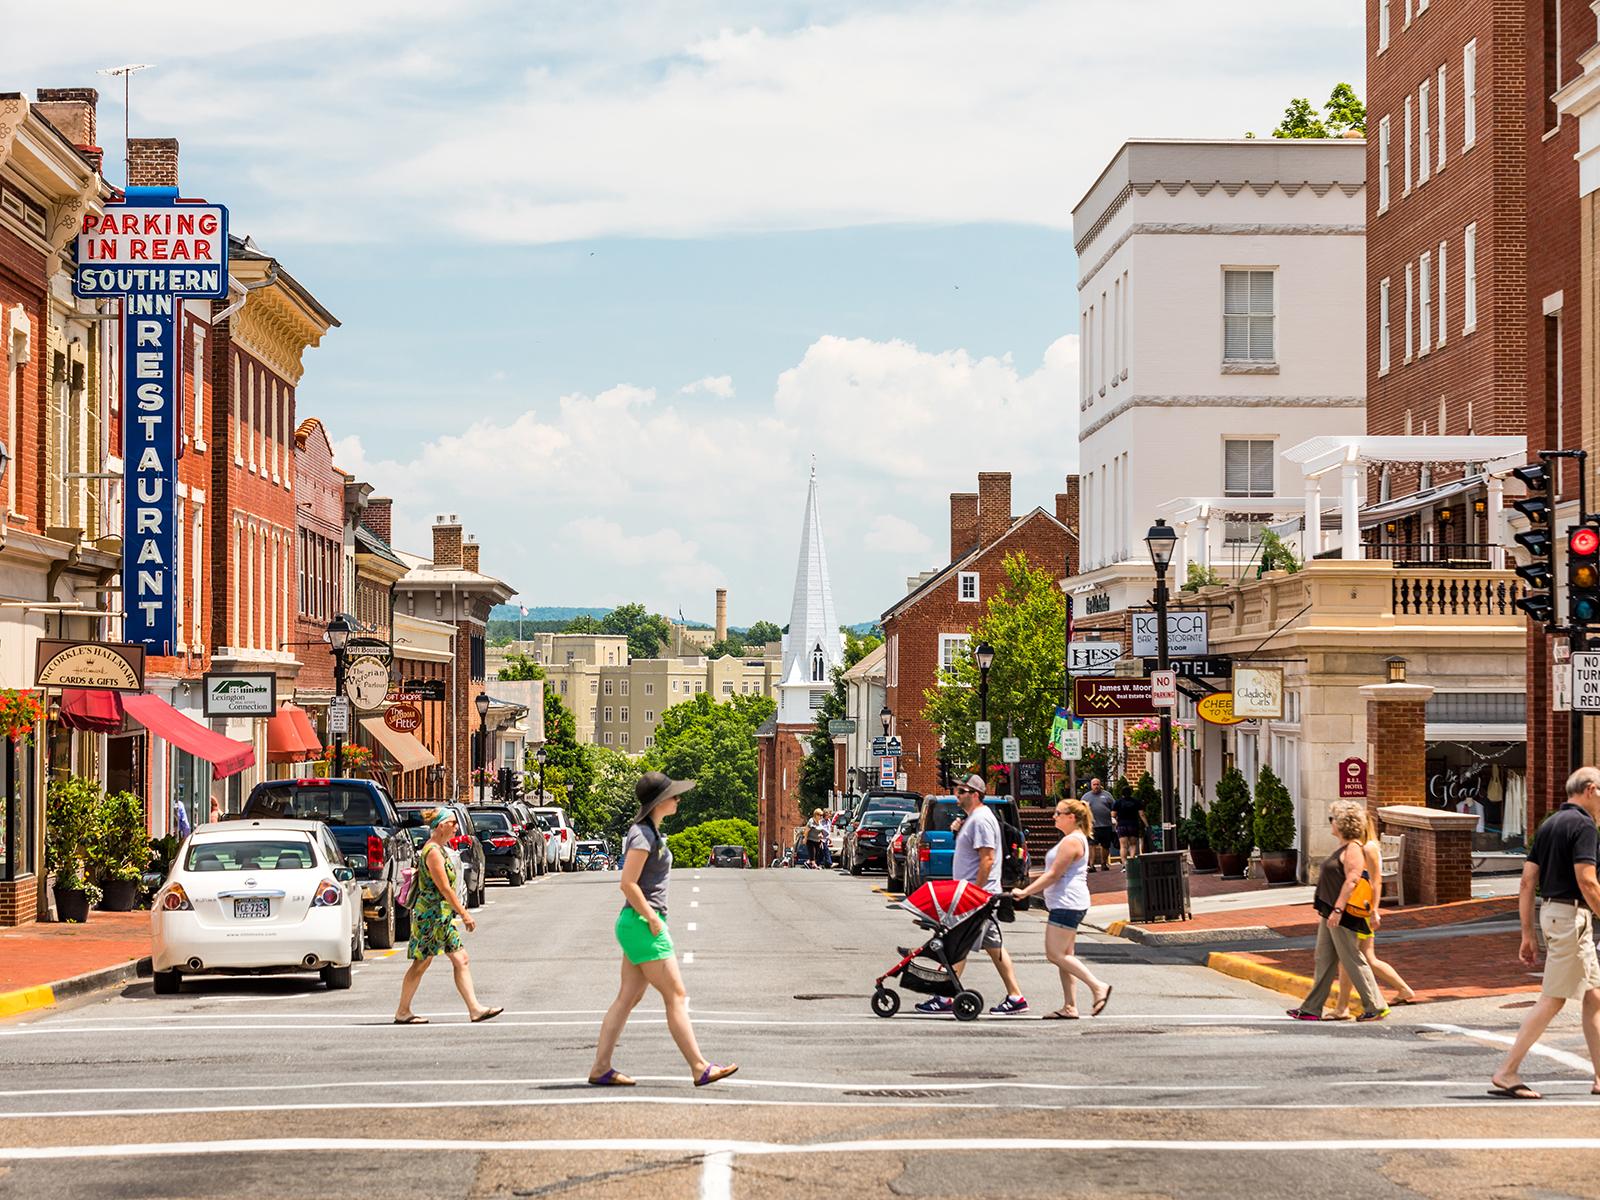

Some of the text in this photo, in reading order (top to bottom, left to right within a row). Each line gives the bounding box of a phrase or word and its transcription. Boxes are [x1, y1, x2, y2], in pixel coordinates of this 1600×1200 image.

[82, 213, 218, 235] PARKING
[88, 239, 213, 260] IN REAR
[80, 268, 218, 291] SOUTHERN
[128, 294, 172, 315] INN
[136, 320, 165, 628] RESTAURANT
[1136, 616, 1203, 634] ROCCA
[1073, 648, 1119, 667] HESS
[1584, 656, 1598, 667] NO
[41, 646, 137, 687] McCORKLE'S HALLMARK
[1169, 661, 1215, 675] OTEL
[59, 675, 119, 686] CARDS & GIFTS
[1156, 677, 1170, 686] NO
[1584, 682, 1598, 693] ON
[212, 694, 246, 702] Lexington
[1203, 700, 1232, 709] CHEE
[1581, 696, 1600, 706] RED
[395, 718, 417, 729] Attic
